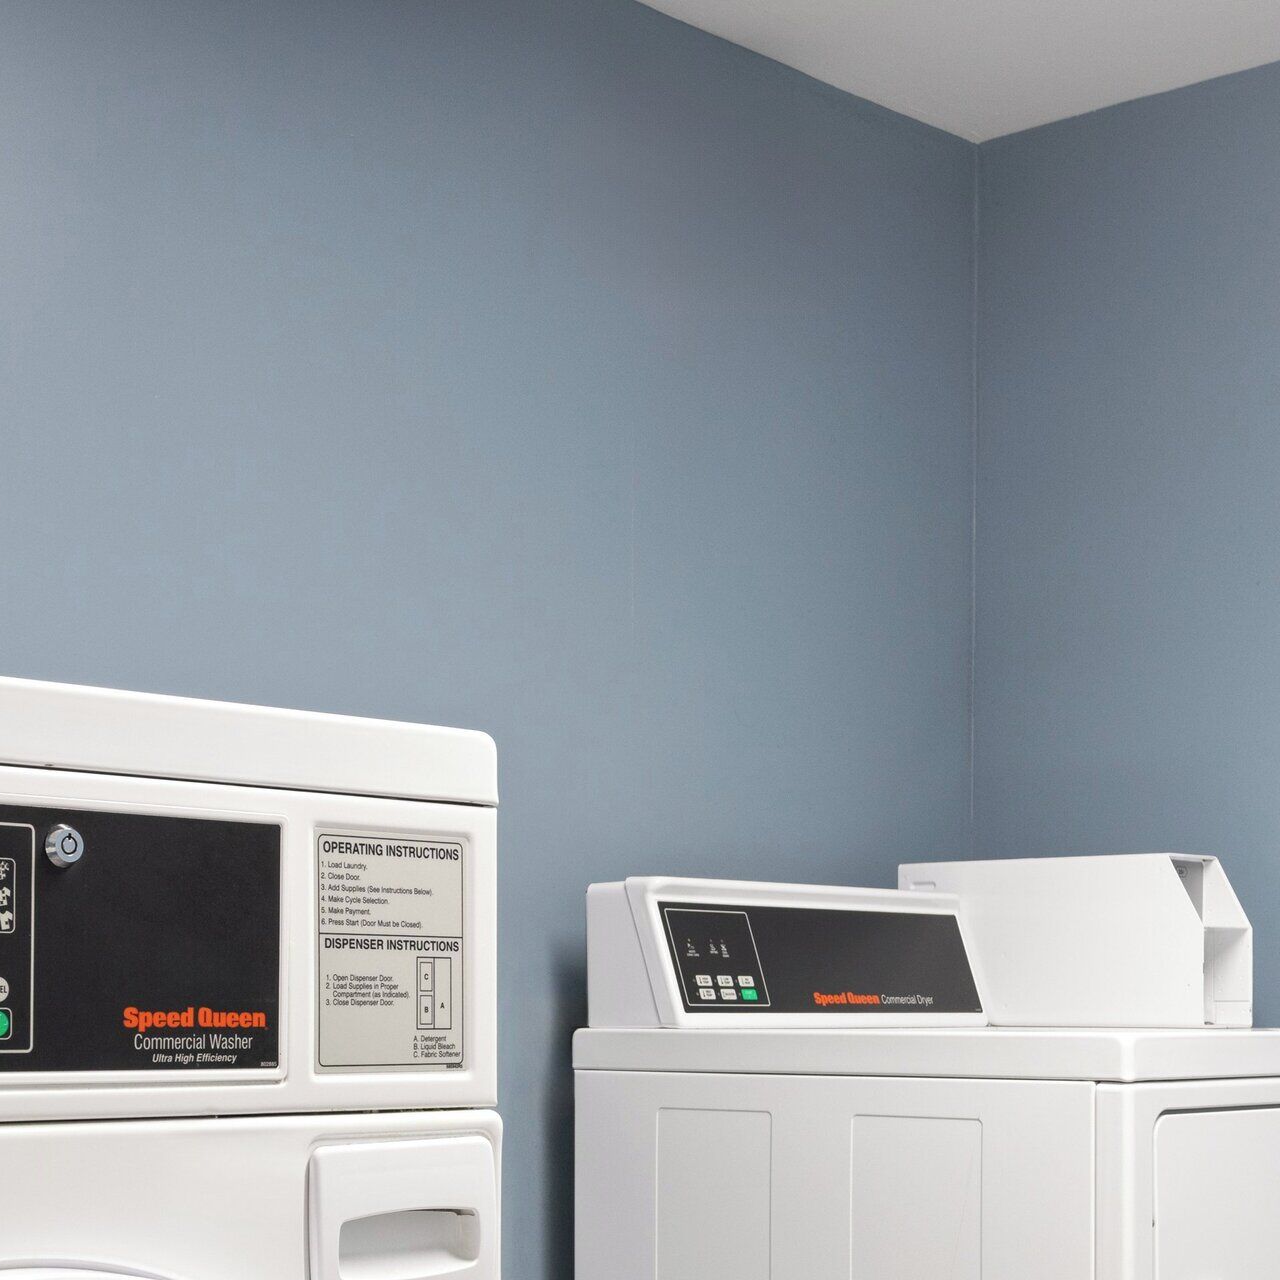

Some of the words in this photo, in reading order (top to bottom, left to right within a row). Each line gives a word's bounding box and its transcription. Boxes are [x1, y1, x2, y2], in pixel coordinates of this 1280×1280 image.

[323, 840, 383, 856] OPERATING
[385, 844, 459, 861] INSTRUCTIONS
[343, 862, 368, 871] Laundry.
[328, 872, 345, 880] Close
[341, 884, 366, 893] Supplies
[381, 886, 412, 894] Instructions
[414, 887, 434, 896] Below).
[345, 896, 361, 905] Cycle
[345, 907, 371, 916] Payment.
[328, 918, 344, 926] Press
[361, 919, 376, 927] (Door
[401, 920, 423, 930] Closed).
[324, 937, 384, 950] DISPENSER
[386, 939, 460, 952] INSTRUCTIONS
[332, 974, 349, 982] Open
[349, 974, 378, 983] Dispenser
[424, 973, 429, 981] C
[348, 983, 373, 992] Supplies
[380, 983, 399, 992] Proper
[332, 990, 372, 998] Compartment
[371, 991, 382, 999] (as
[382, 991, 410, 999] Indicated).
[813, 991, 847, 1007] Speed
[846, 991, 880, 1005] Queen
[880, 993, 917, 1005] Commercial
[916, 994, 934, 1007] Dryer
[350, 999, 379, 1007] Dispenser
[379, 999, 395, 1007] Door.
[123, 1006, 195, 1033] Speed
[197, 1006, 267, 1029] Queen
[133, 1033, 206, 1050] Commercial
[209, 1033, 253, 1050] Washer
[420, 1035, 447, 1043] Detergent
[420, 1043, 437, 1051] Liquid
[152, 1053, 173, 1063] Ultra
[174, 1053, 194, 1064] High
[196, 1053, 238, 1064] Efficiency
